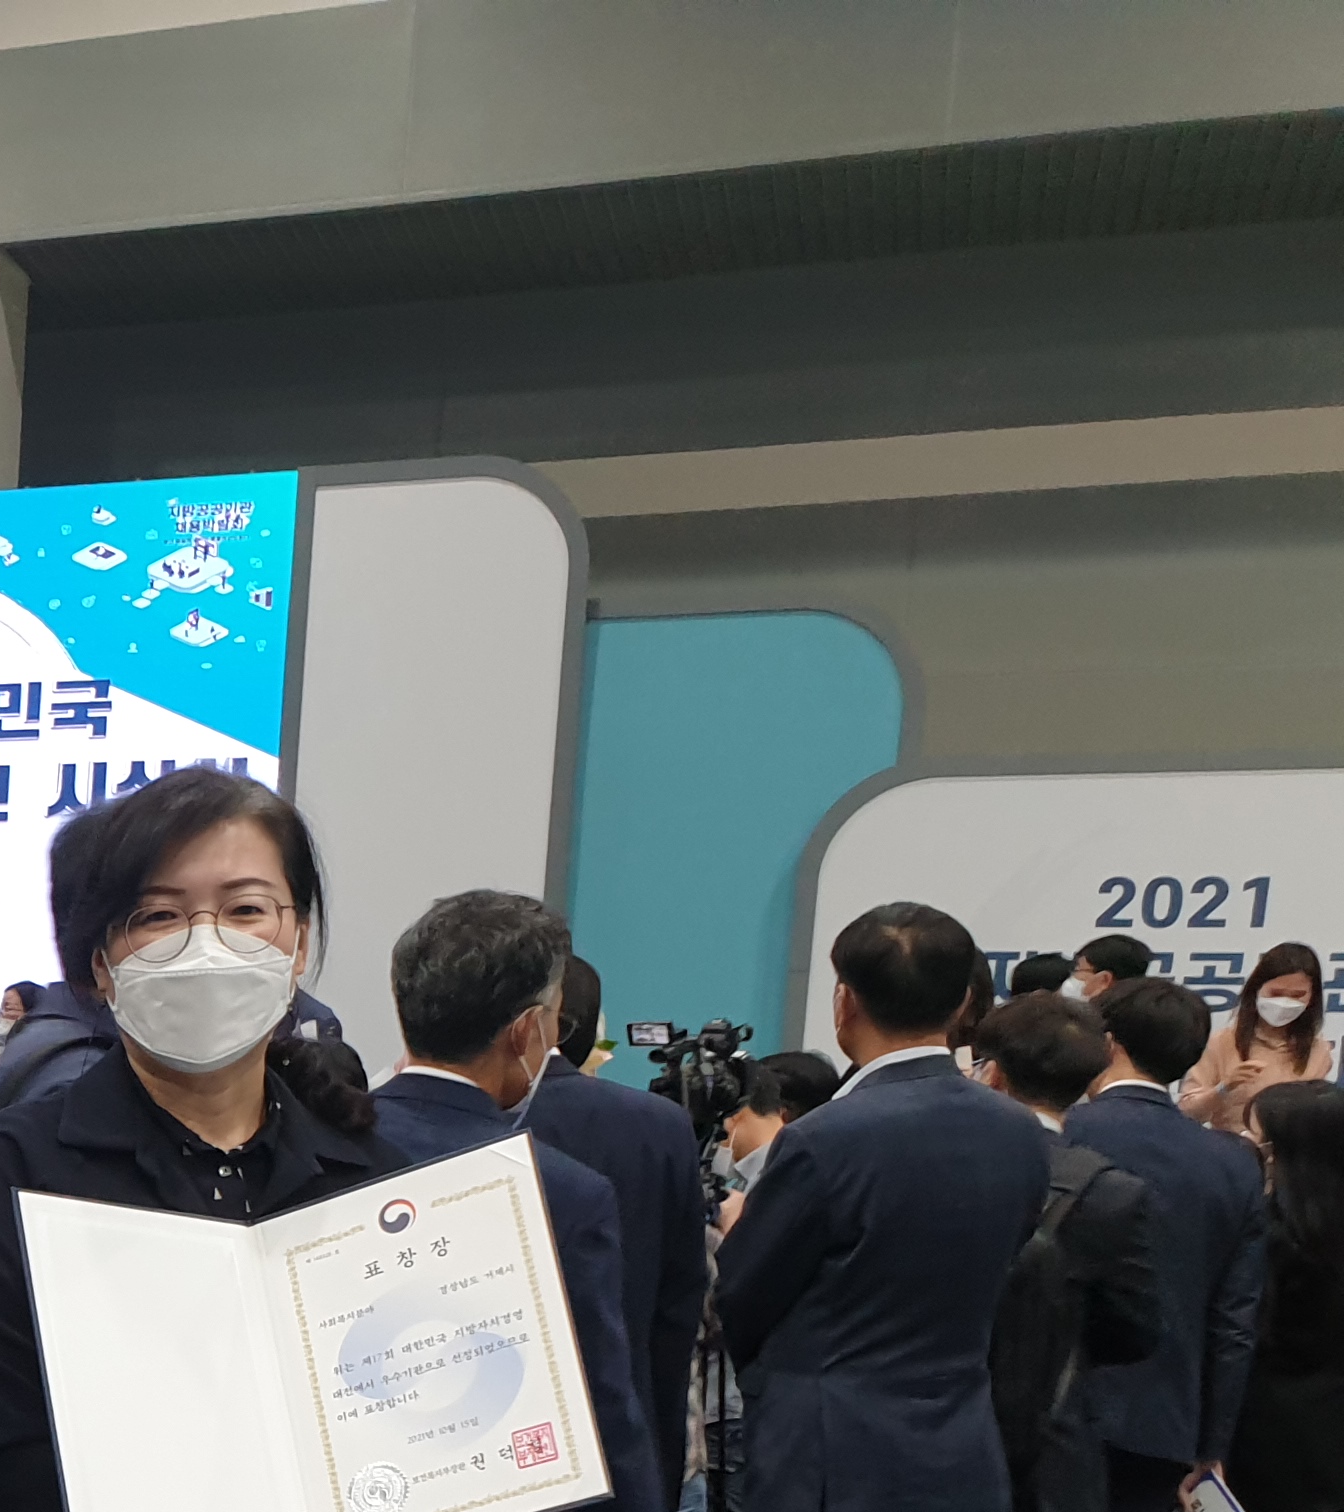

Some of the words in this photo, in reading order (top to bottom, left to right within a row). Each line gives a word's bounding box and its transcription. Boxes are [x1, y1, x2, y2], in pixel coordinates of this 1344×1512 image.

[1094, 876, 1271, 928] 2021
[438, 1276, 480, 1295] 경상남도
[402, 1333, 448, 1354] 대한민국
[454, 1309, 524, 1338] 지방자치경영
[337, 1407, 358, 1422] 이에
[364, 1390, 420, 1415] 표창합니다
